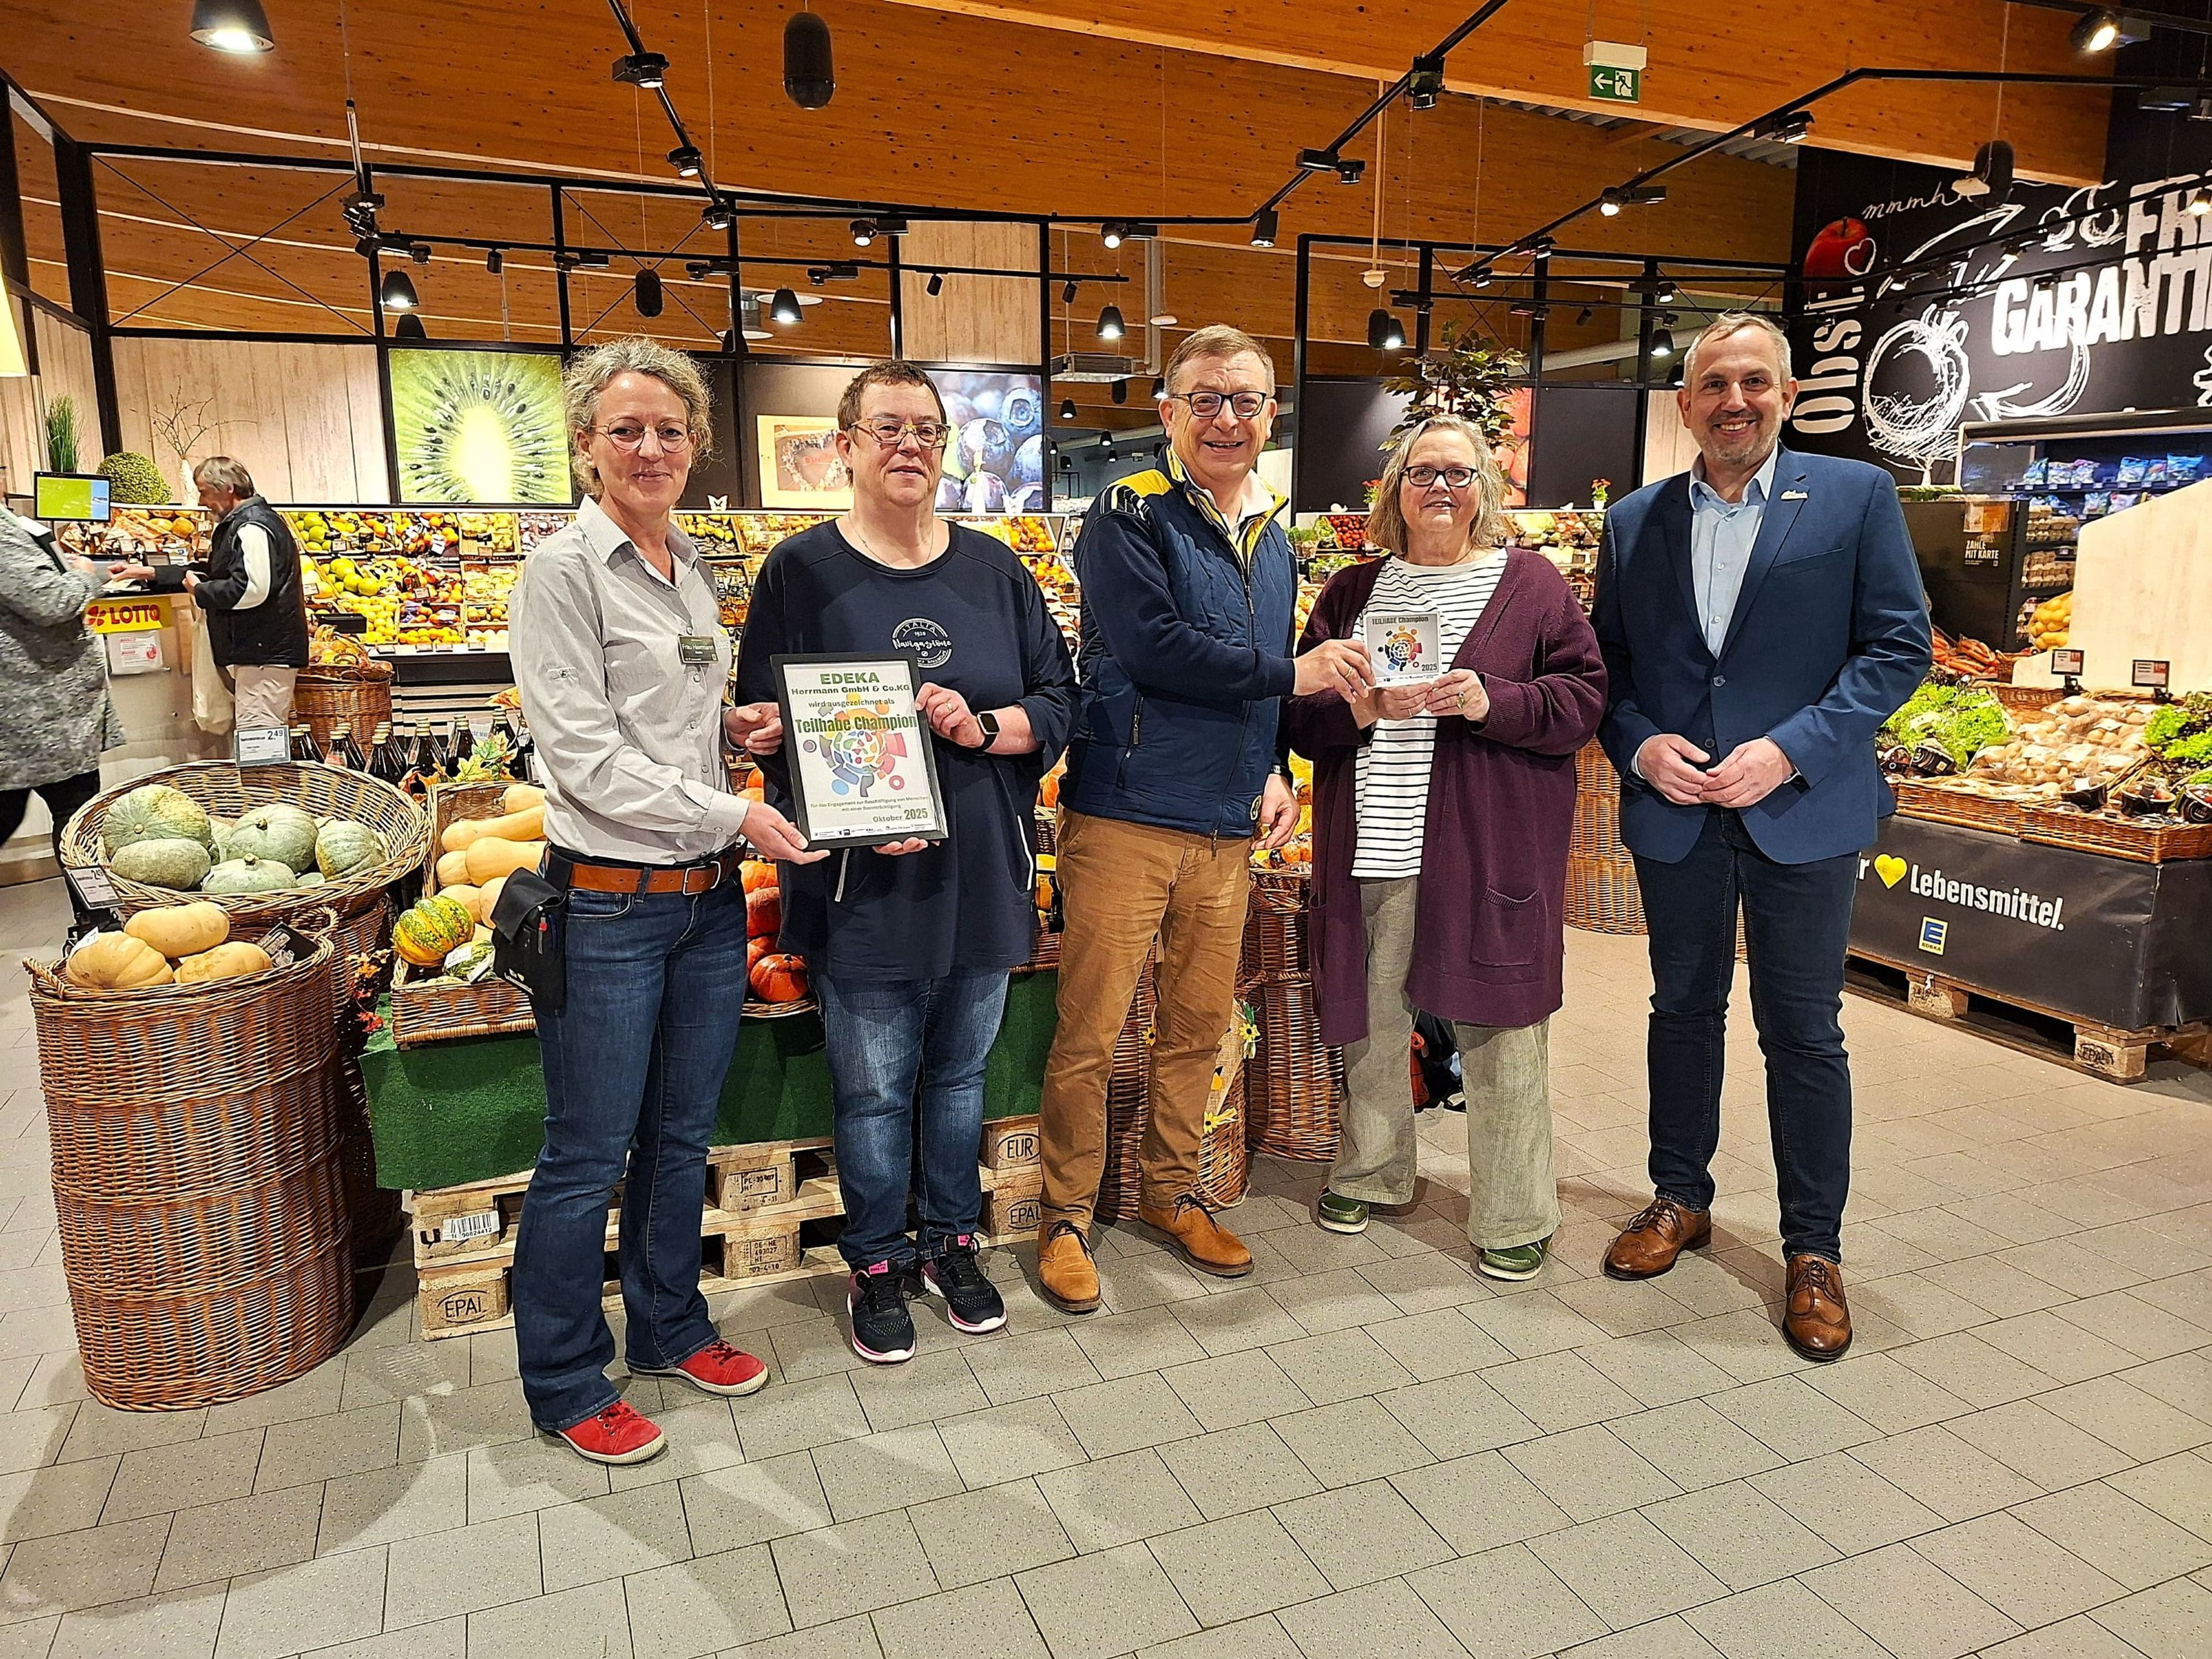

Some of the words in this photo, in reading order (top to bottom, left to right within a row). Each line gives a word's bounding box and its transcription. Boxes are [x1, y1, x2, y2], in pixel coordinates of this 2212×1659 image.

[1965, 550, 1978, 559] MIT
[1978, 550, 1999, 559] KARTE
[109, 604, 161, 624] LOTTO
[902, 622, 936, 632] ITALIA
[892, 638, 952, 651] Navigazione
[820, 672, 880, 685] EDEKA
[828, 698, 882, 708] ausgezeichnet
[795, 718, 851, 733] Teilhabe
[854, 714, 917, 730] Champion
[267, 730, 283, 740] 2.49
[904, 808, 929, 820] 2025
[1910, 863, 2065, 931] Lebensmittel.
[1921, 942, 1942, 952] EDEKA
[1007, 1137, 1033, 1158] EUR
[1010, 1206, 1042, 1225] EPAL
